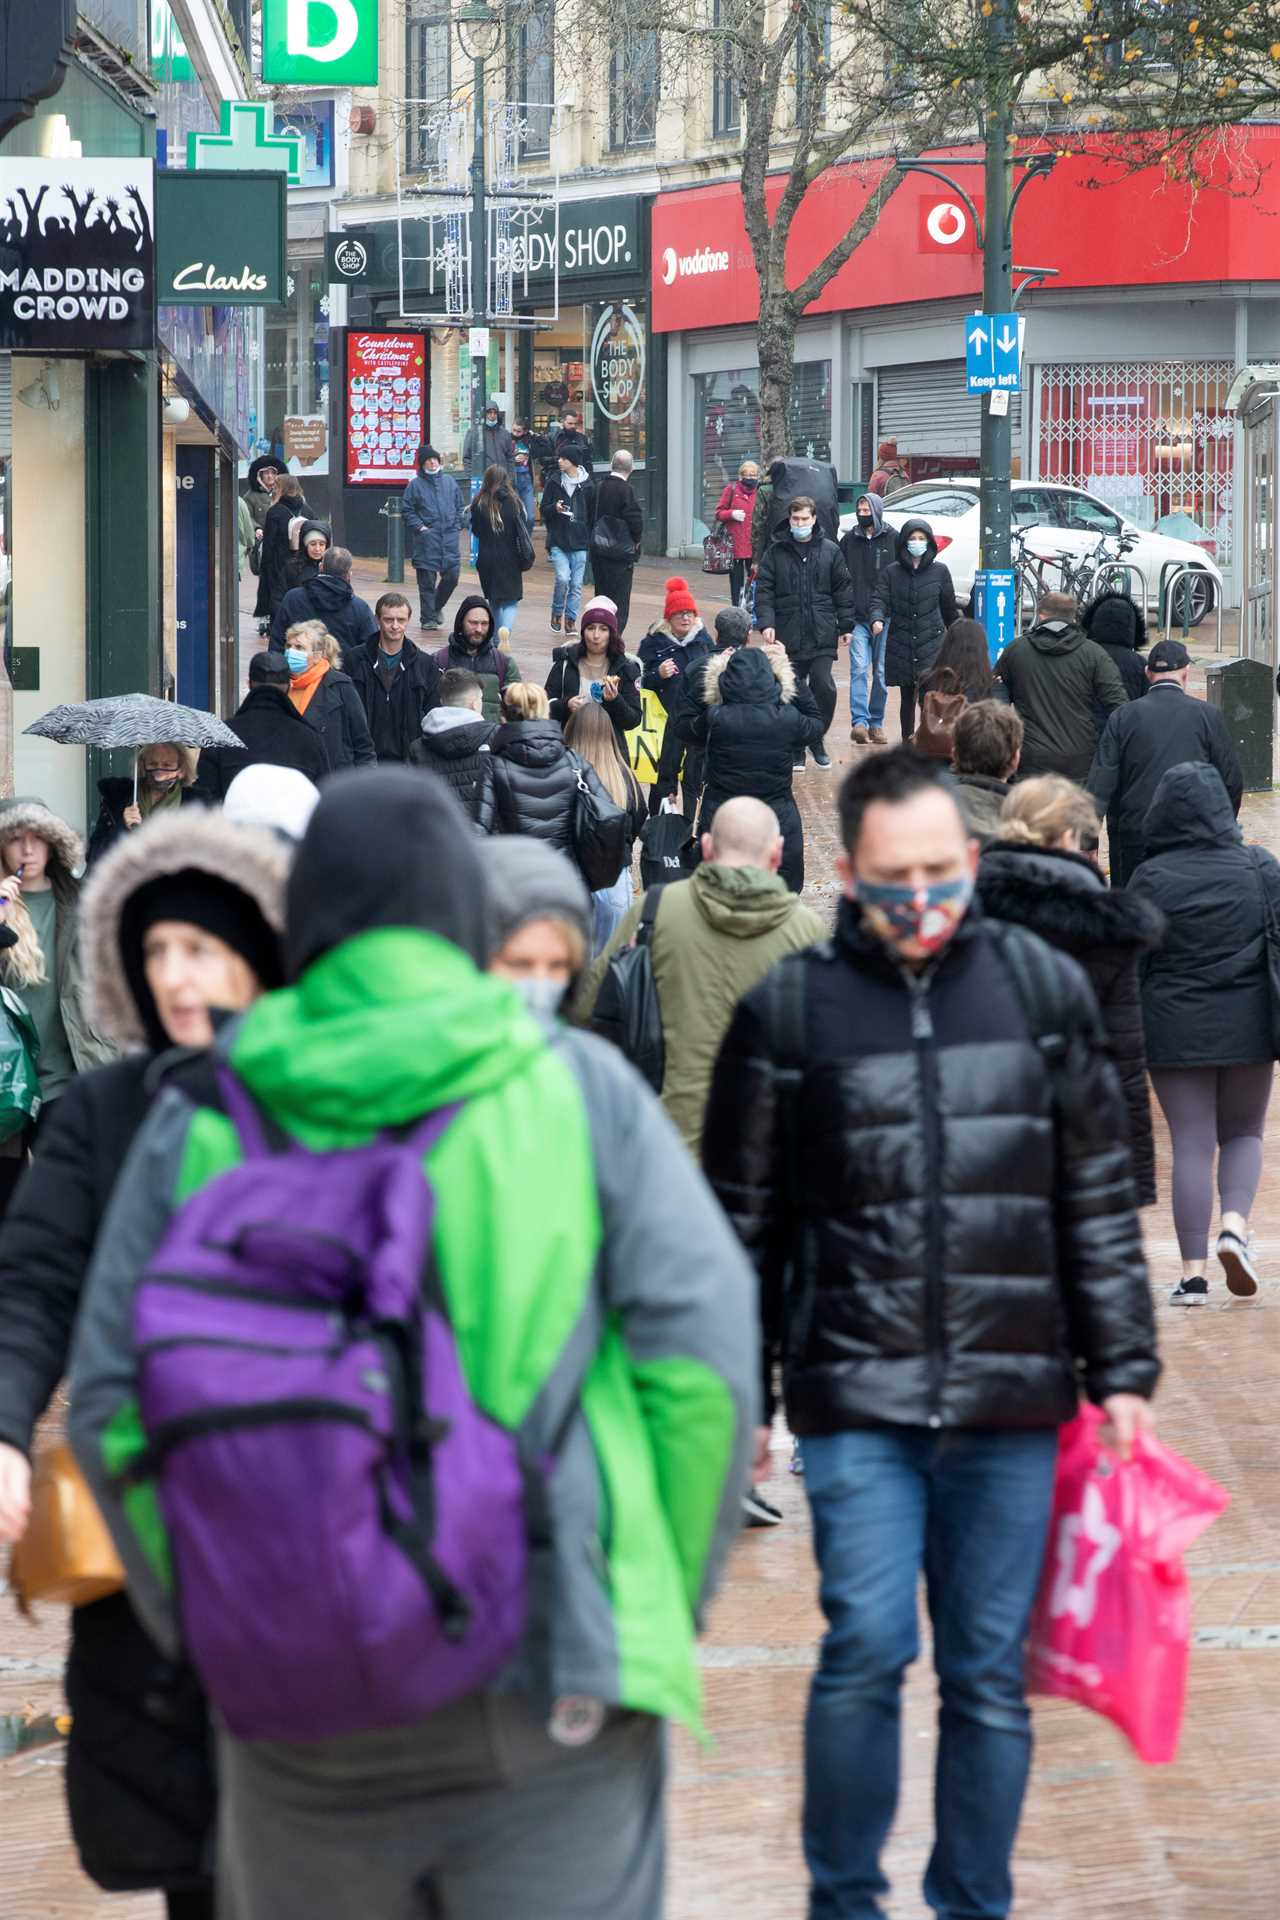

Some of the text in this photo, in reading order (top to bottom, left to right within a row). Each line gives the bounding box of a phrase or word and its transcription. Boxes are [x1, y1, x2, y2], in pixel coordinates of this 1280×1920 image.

[342, 262, 360, 270] SHOP
[679, 246, 729, 276] vodafone
[0, 267, 145, 292] MADDING
[173, 262, 267, 291] Clarks
[13, 295, 129, 320] CROWD
[358, 335, 414, 348] Countdown
[608, 340, 628, 356] THE
[362, 348, 410, 360] Christmas
[601, 358, 635, 378] BODY
[602, 380, 634, 399] SHOP
[970, 373, 1018, 388] Keep left
